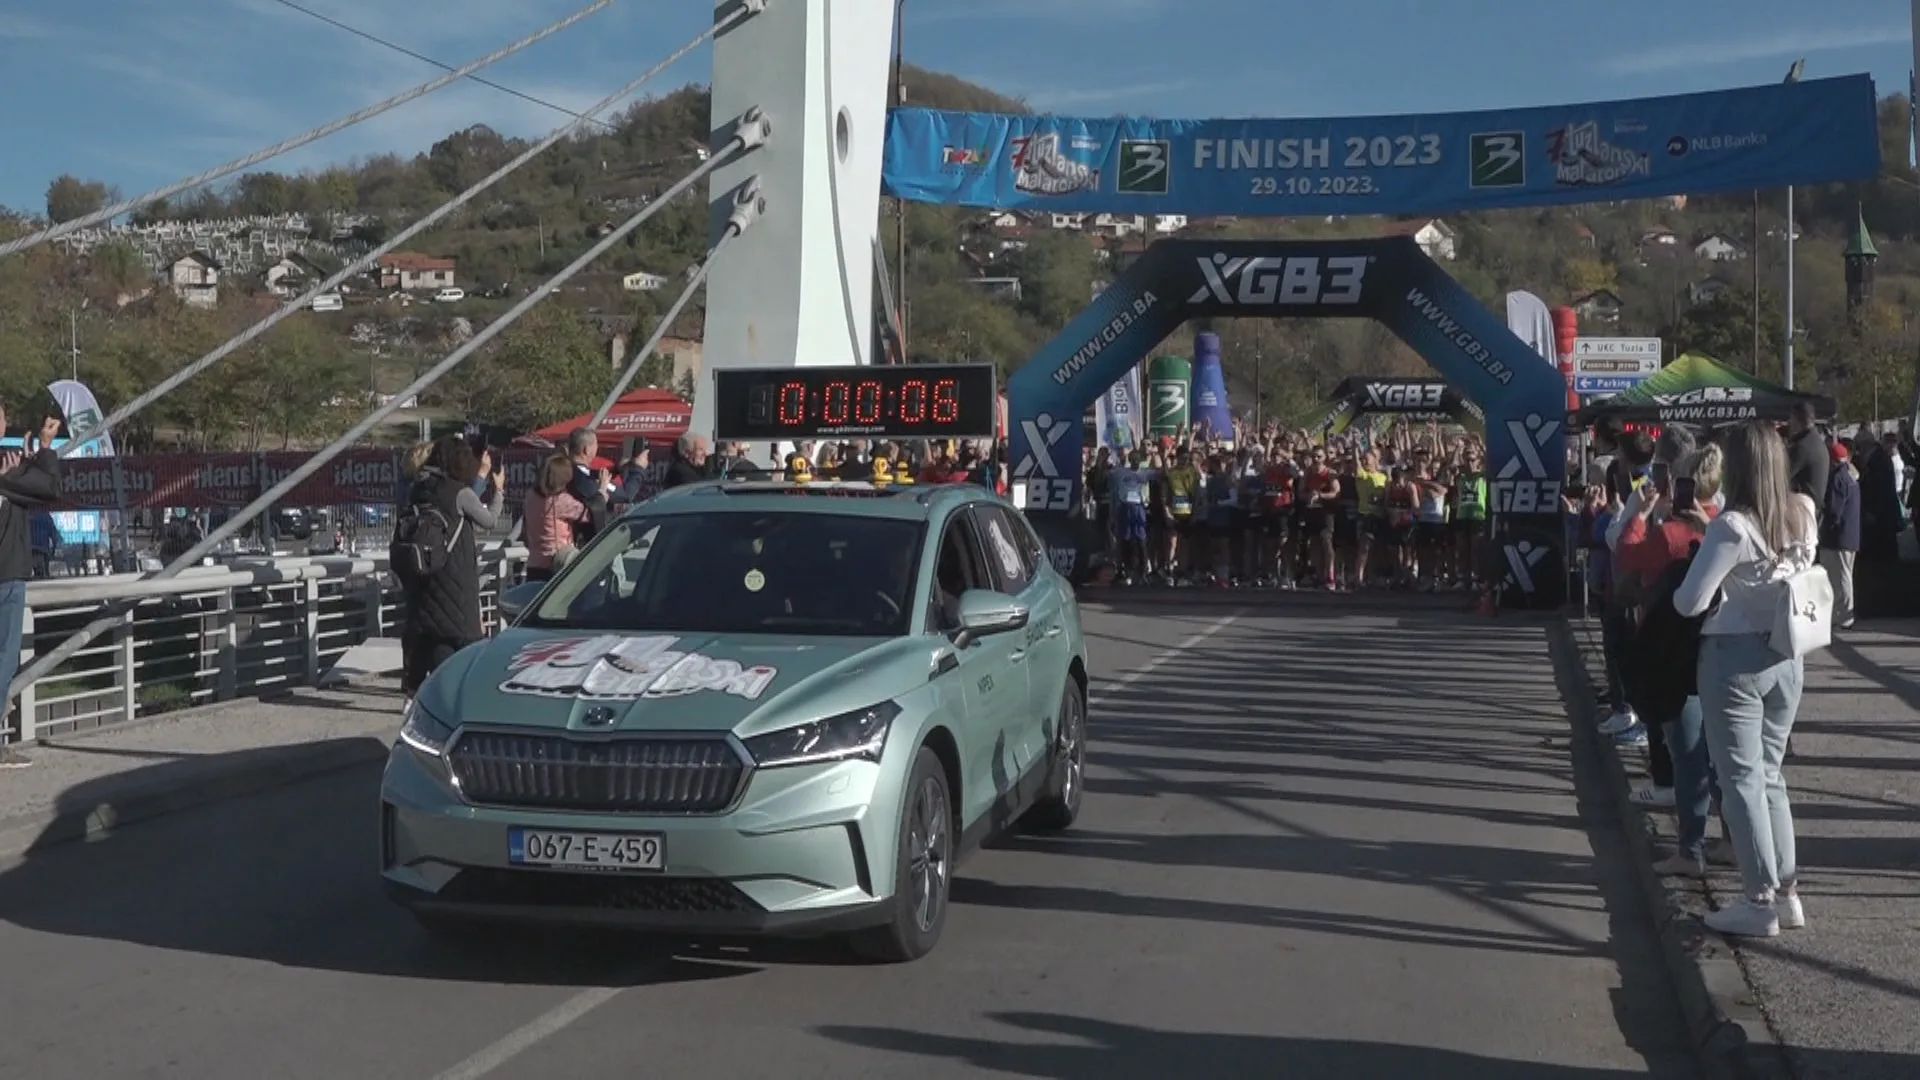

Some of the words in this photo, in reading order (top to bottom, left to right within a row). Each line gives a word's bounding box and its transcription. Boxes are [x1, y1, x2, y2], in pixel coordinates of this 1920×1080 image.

[1194, 138, 1331, 169] FINISH
[1344, 134, 1442, 166] 2023
[1692, 137, 1721, 151] NLB
[1724, 132, 1768, 149] Banka
[1251, 175, 1380, 196] 29.10.2023.
[1052, 290, 1158, 385] WWW.GB3.BA
[1406, 288, 1515, 386] WWW.GB3.BA
[1620, 343, 1644, 353] Tuzla
[1597, 378, 1632, 389] Parking
[779, 380, 958, 424] 0:00:06
[1659, 407, 1757, 420] WWW.GB3.BA
[528, 834, 658, 864] 067-E-459
